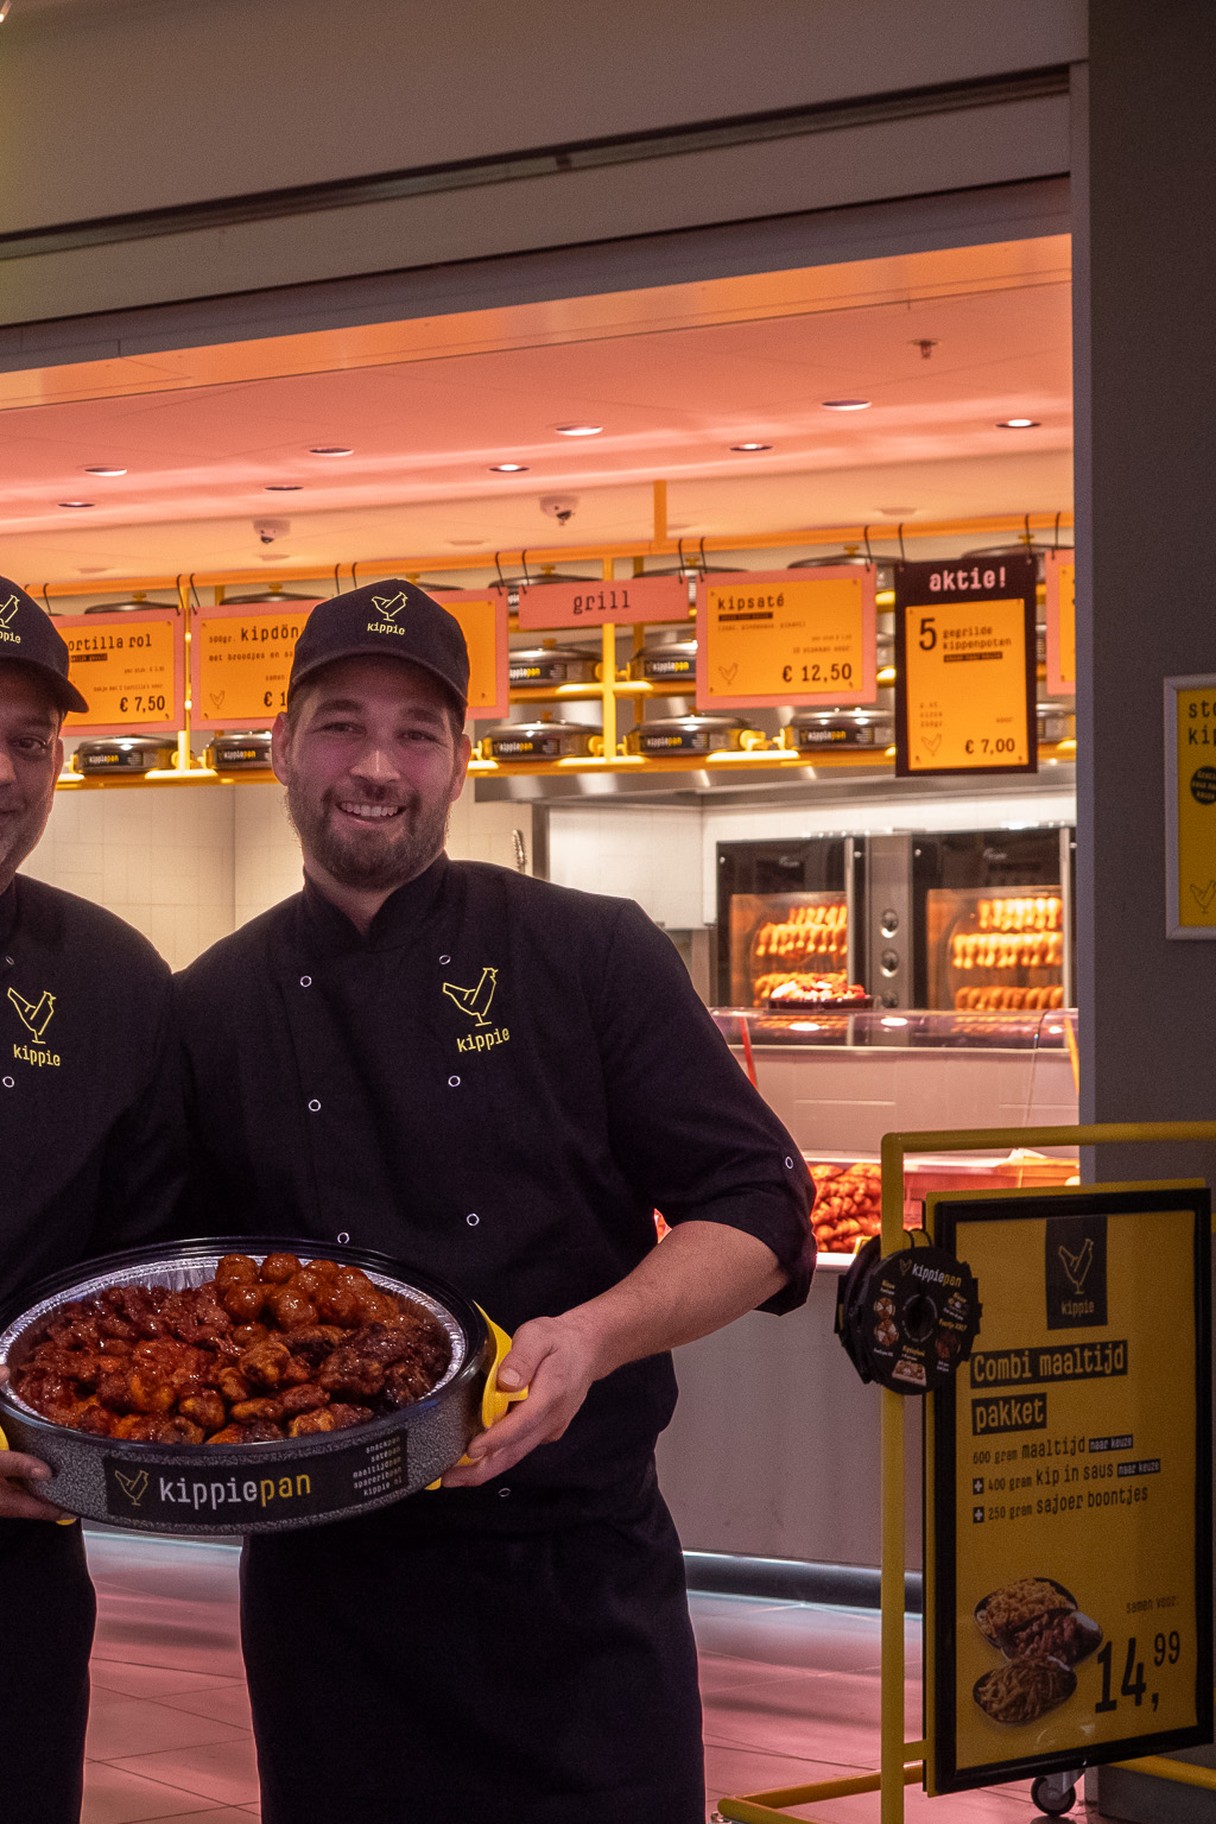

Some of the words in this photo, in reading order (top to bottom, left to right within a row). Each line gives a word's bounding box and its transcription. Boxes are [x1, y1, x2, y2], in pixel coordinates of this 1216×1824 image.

[929, 566, 1006, 591] aktie!
[572, 590, 631, 615] grill
[718, 593, 784, 611] kipsaté
[241, 624, 299, 642] kipdön
[367, 621, 405, 636] kippie
[919, 617, 936, 651] 5
[68, 636, 123, 651] ortilla
[129, 633, 152, 648] rol
[782, 665, 792, 682] €
[802, 663, 852, 683] 12,50
[120, 697, 128, 712] €
[135, 695, 165, 713] 7,50
[264, 691, 272, 707] €
[965, 739, 974, 754] €
[981, 738, 1015, 755] 7,00
[456, 1025, 510, 1053] kippie
[12, 1043, 61, 1067] kippie
[912, 1263, 963, 1288] kippiepan
[1061, 1299, 1095, 1317] kippie
[973, 1351, 1032, 1383] Combi
[1039, 1343, 1124, 1376] maaltijd
[975, 1398, 1044, 1433] pakket
[973, 1451, 991, 1465] 600
[995, 1448, 1018, 1465] gram
[1021, 1436, 1085, 1459] maaltijd
[988, 1477, 1006, 1491] 400
[1009, 1475, 1032, 1492] gram
[1036, 1468, 1059, 1487] kip
[1064, 1464, 1079, 1482] in
[1083, 1463, 1114, 1480] saus
[159, 1473, 311, 1510] kippiepan
[988, 1506, 1006, 1521] 250
[1009, 1504, 1032, 1520] gram
[1036, 1493, 1084, 1515] sajoer
[1088, 1486, 1148, 1507] boontjes
